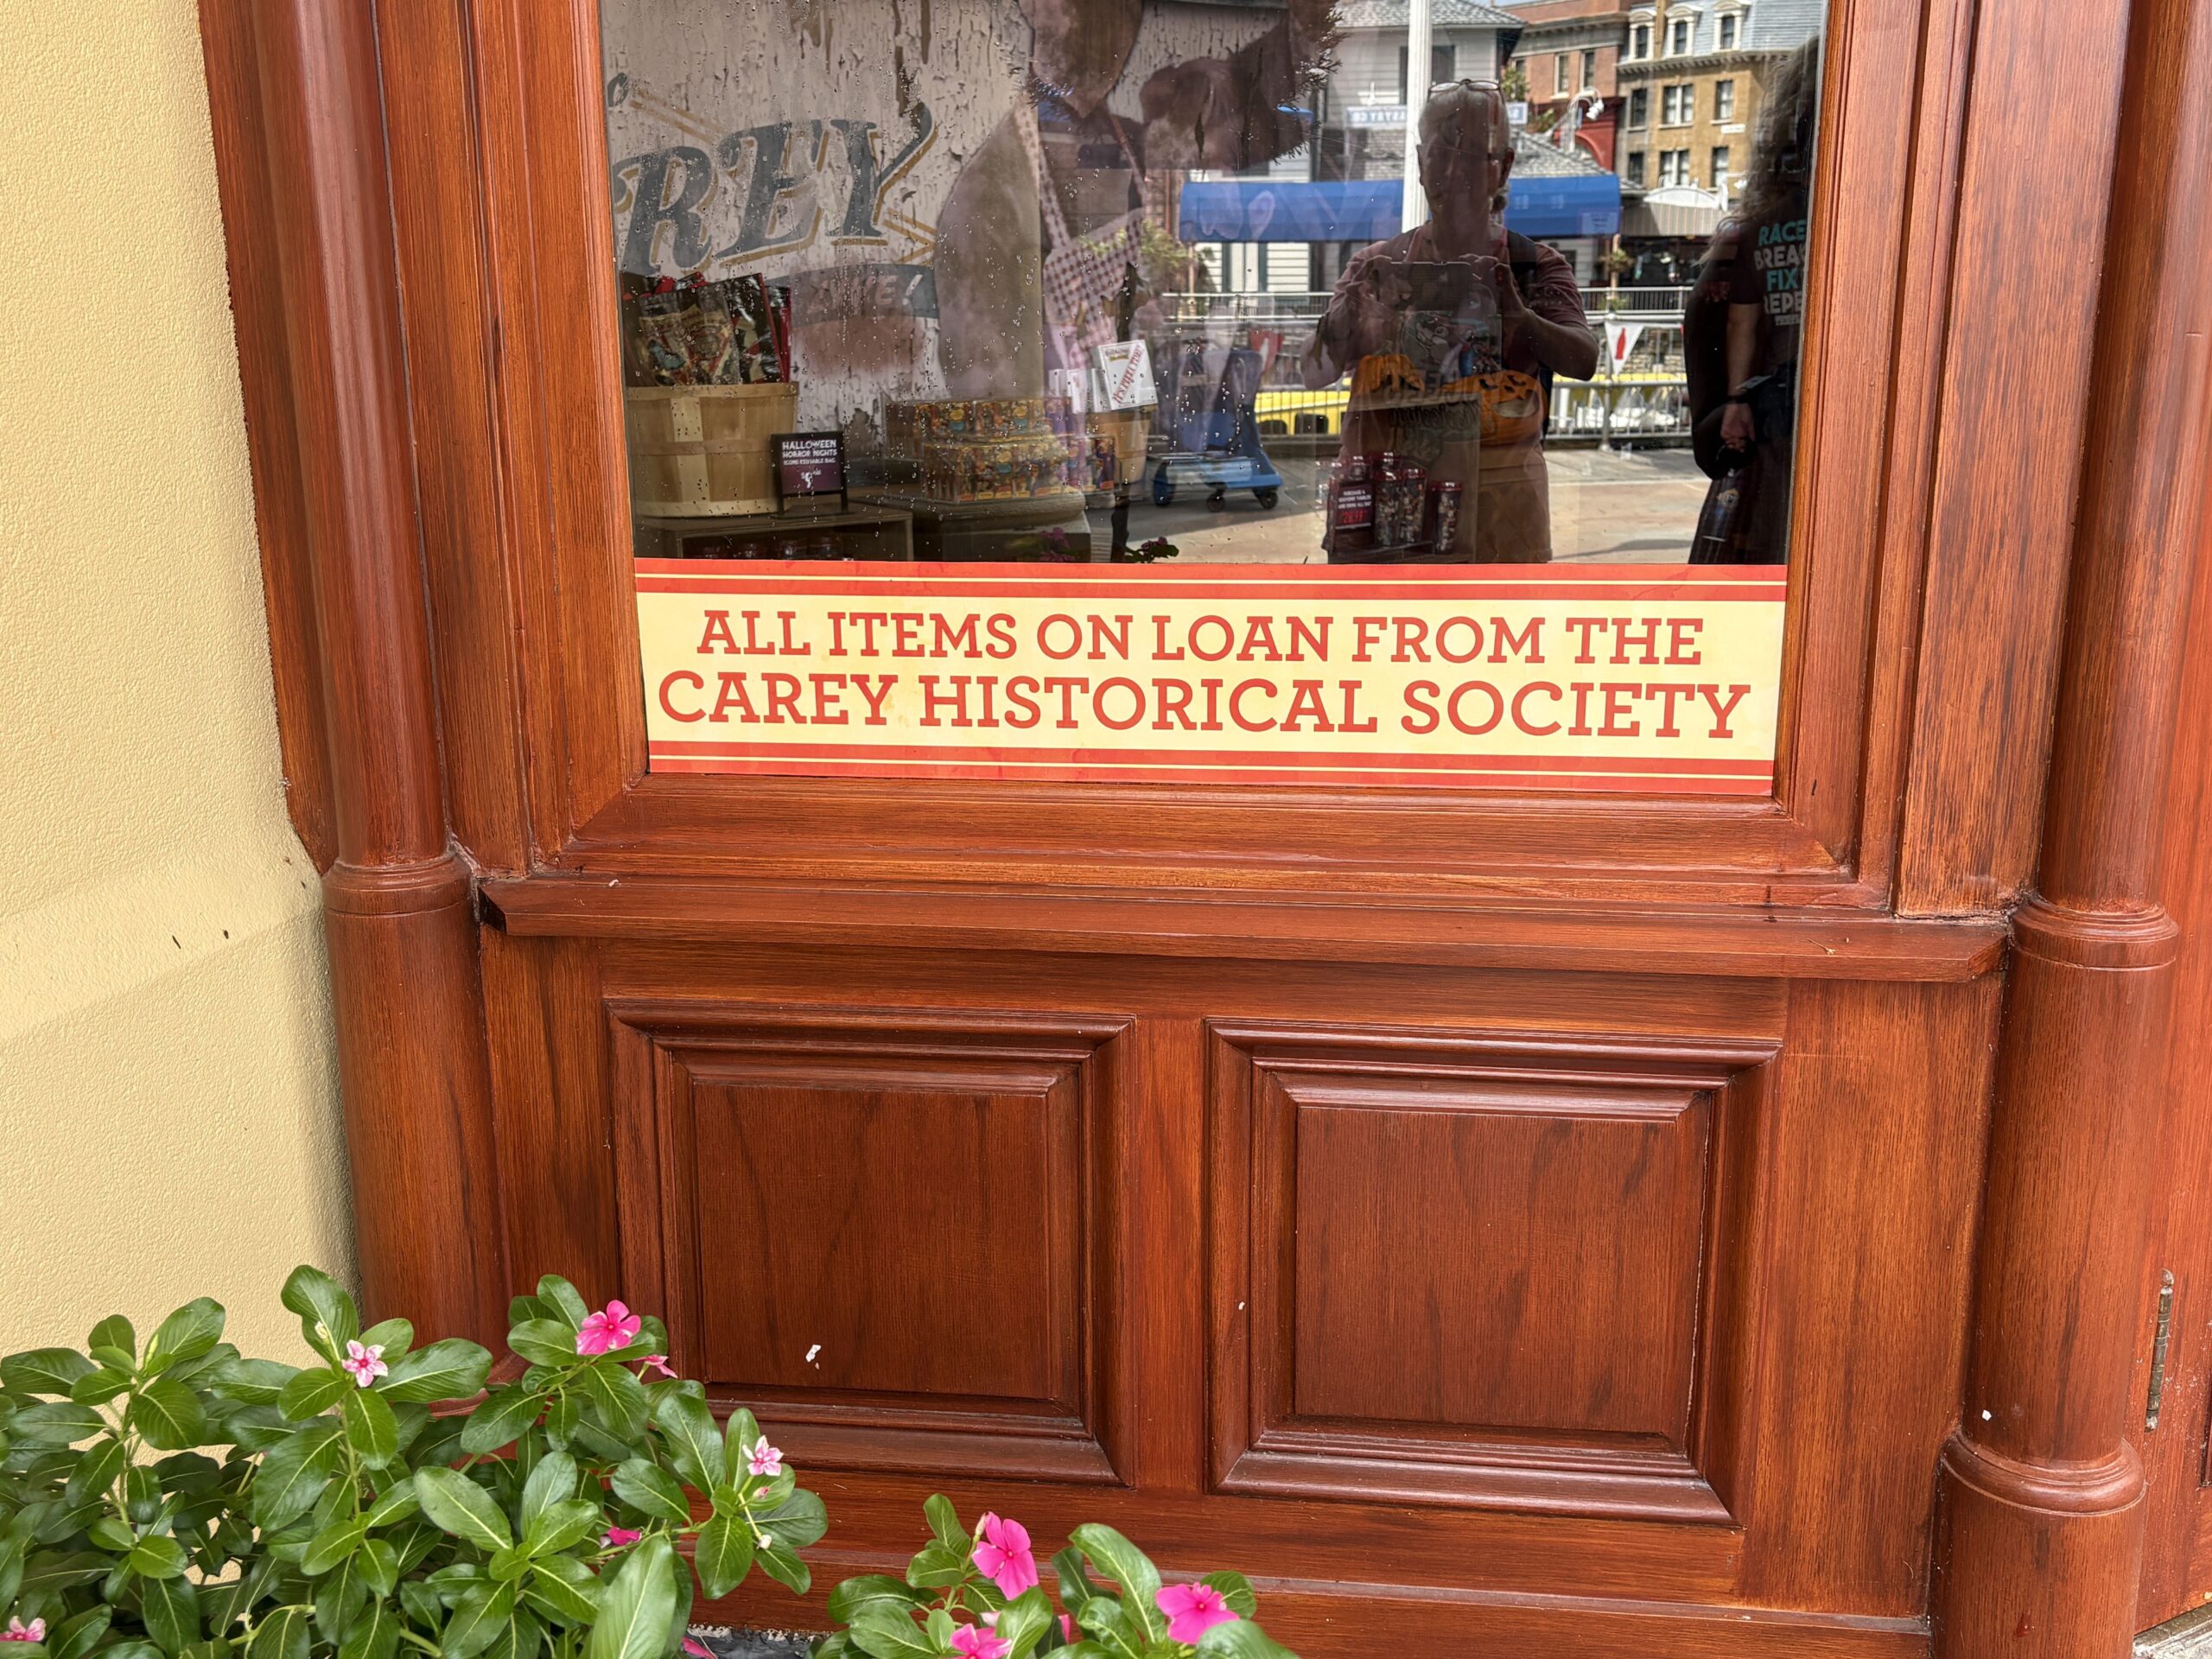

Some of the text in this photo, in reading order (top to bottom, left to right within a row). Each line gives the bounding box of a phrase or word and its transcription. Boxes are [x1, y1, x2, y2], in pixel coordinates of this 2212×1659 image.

[1758, 219, 1807, 246] RACE
[1766, 268, 1799, 292] FIX
[781, 439, 837, 450] HALLOWEEN
[781, 448, 837, 459] HORROR NIGHTS
[697, 610, 1703, 665] ALL ITEMS ON LOAN FROM THE
[659, 671, 1751, 739] CAREY HISTORICAL SOCIETY
